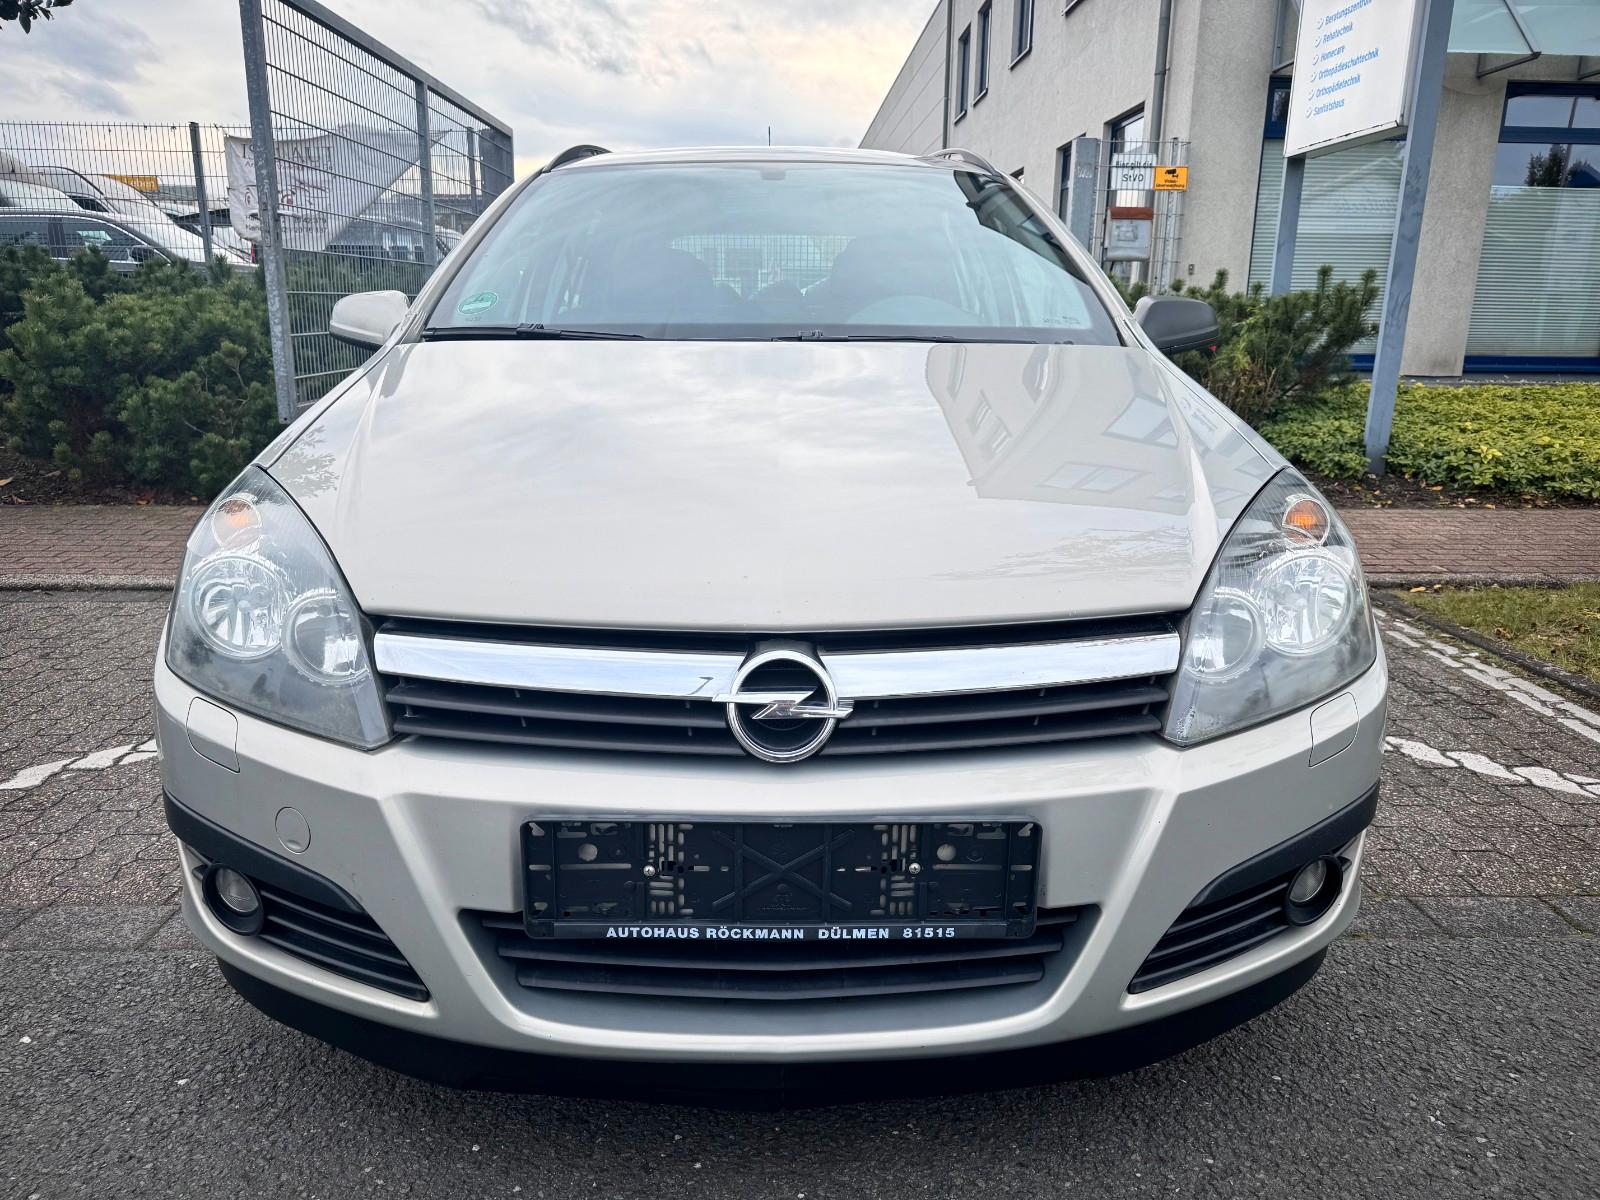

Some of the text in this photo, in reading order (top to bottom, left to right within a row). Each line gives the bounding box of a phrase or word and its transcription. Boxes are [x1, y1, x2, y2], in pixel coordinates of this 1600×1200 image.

[1323, 22, 1353, 43] Rehatechnik
[1320, 46, 1345, 61] Homecare
[1319, 48, 1379, 80] Orthopädieschuhtechnik
[1316, 74, 1361, 97] Orthopädietechnik
[1122, 174, 1144, 183] StVO
[606, 925, 956, 939] AUTOHAUS RÖCKMANN DÜLMEN 81515
